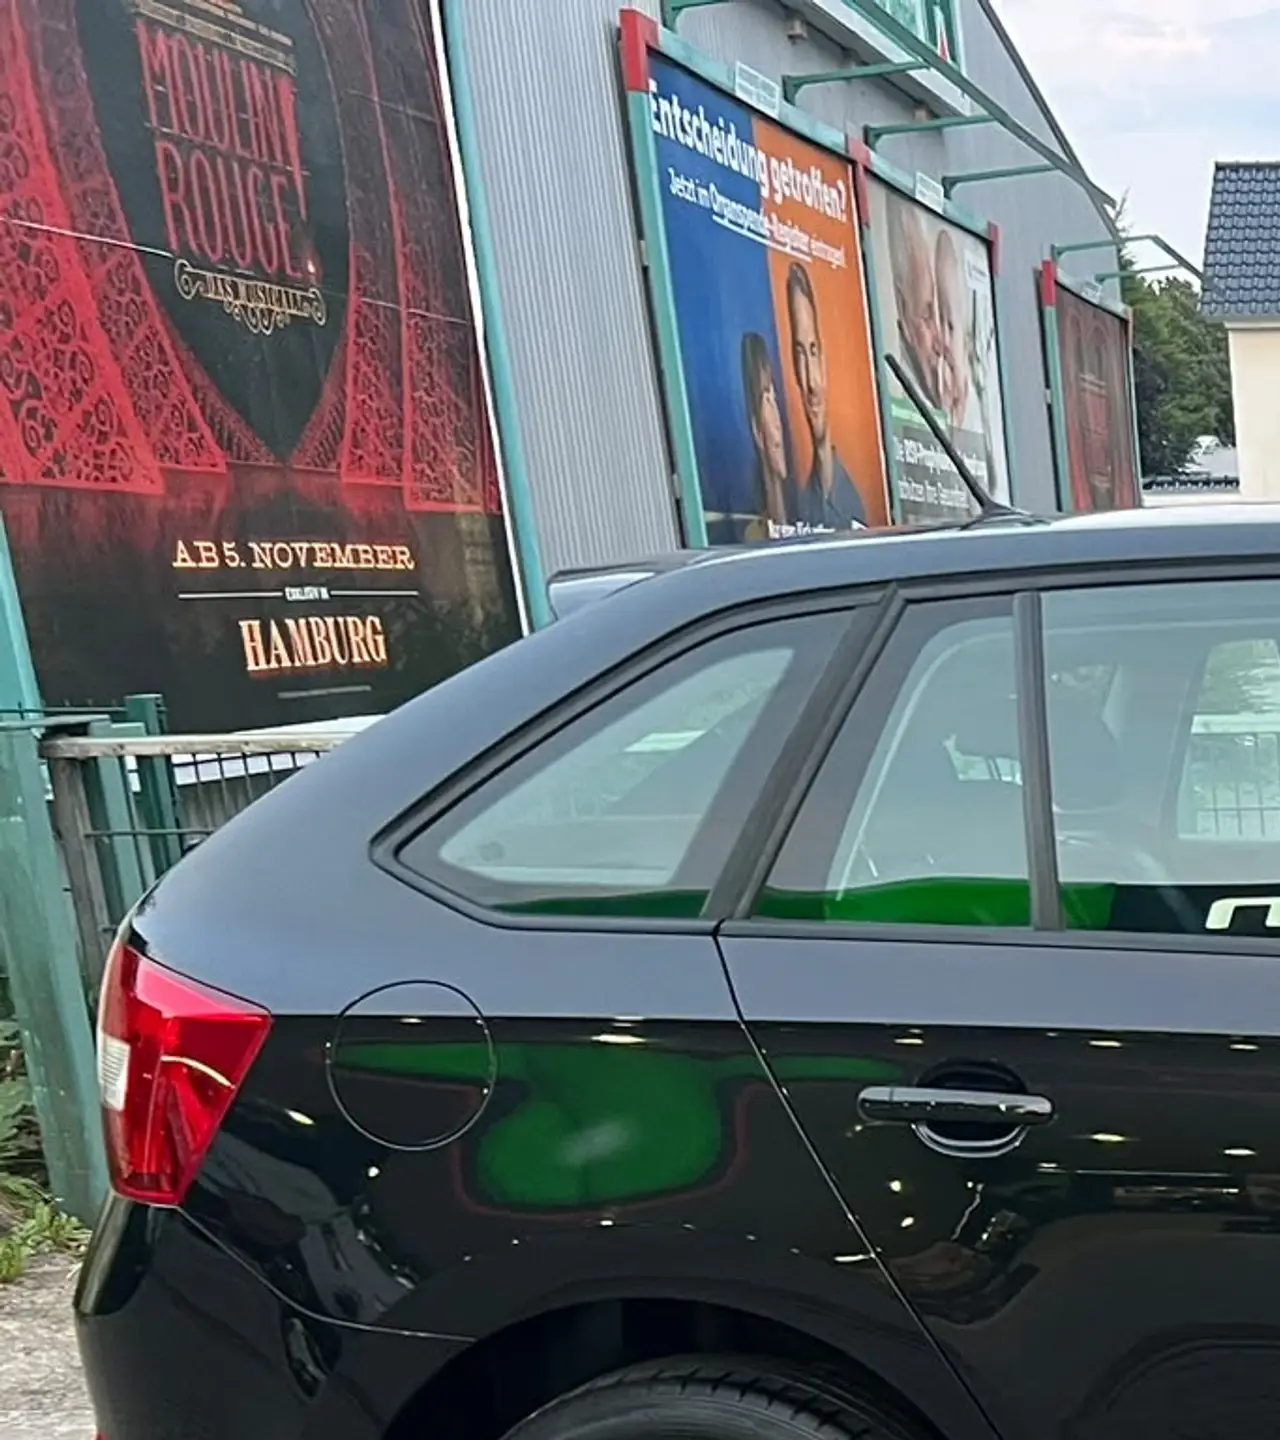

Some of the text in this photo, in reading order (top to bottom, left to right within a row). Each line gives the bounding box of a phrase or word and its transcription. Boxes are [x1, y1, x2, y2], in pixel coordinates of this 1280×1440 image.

[135, 19, 285, 166] MOULIN
[648, 77, 769, 197] Entscheidung
[770, 156, 847, 222] getroffen?
[173, 540, 416, 571] AB 5. NOVEMBER
[238, 615, 387, 671] HAMBURG
